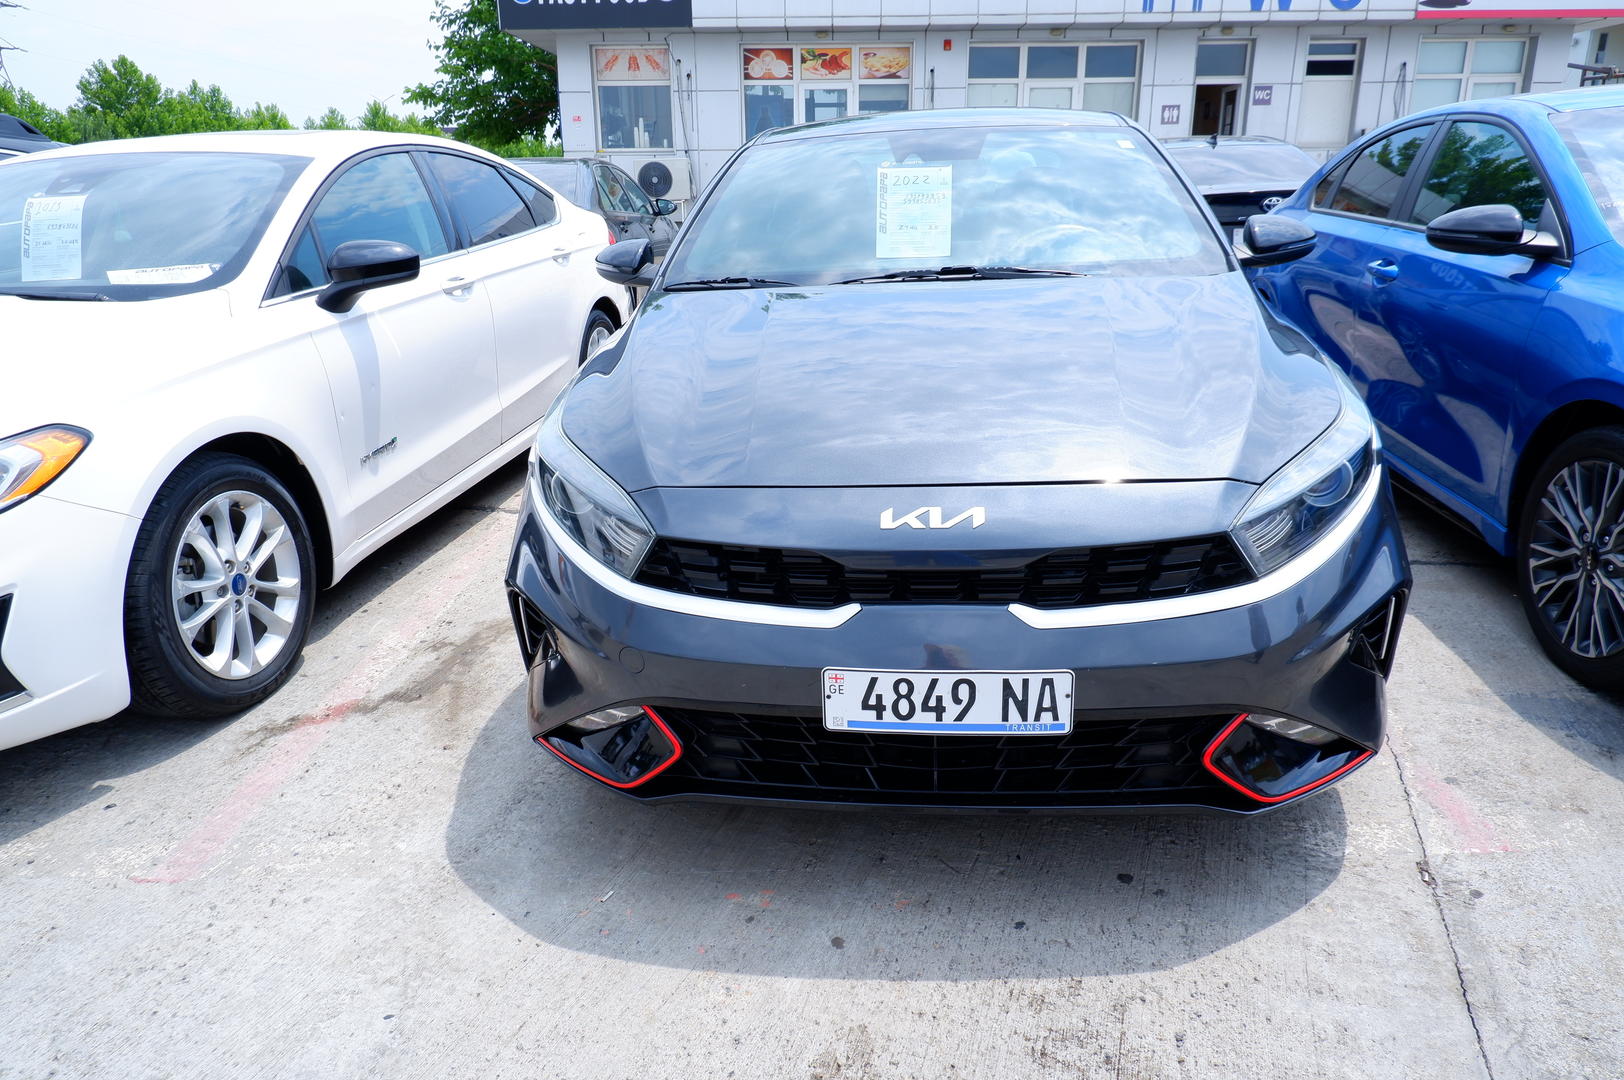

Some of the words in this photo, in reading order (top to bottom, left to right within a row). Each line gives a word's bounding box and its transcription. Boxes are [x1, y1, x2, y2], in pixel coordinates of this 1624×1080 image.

[1255, 90, 1271, 100] WC
[892, 175, 931, 187] 2022
[880, 506, 986, 530] KIA
[828, 684, 845, 695] GE
[861, 676, 977, 723] 4849
[1001, 677, 1060, 723] NA
[1005, 723, 1052, 732] TRANSIT
